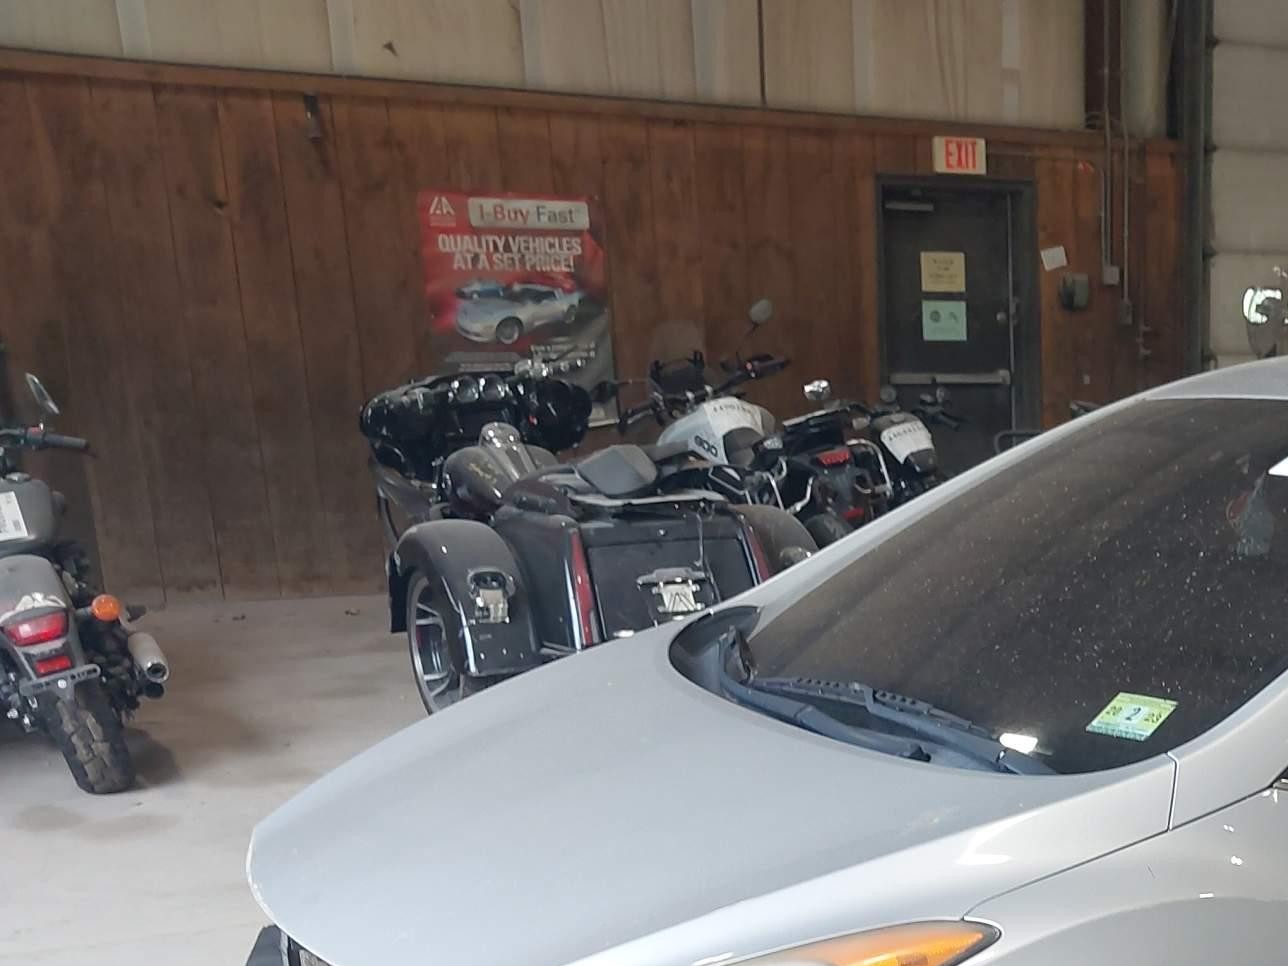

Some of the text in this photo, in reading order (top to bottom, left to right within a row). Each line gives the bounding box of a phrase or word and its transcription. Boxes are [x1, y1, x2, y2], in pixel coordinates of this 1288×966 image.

[944, 139, 977, 169] EXIT
[480, 204, 575, 224] I-Buy Fast
[437, 233, 582, 256] QUALITY VEHICLES
[453, 253, 575, 273] AT A SET PRICE!
